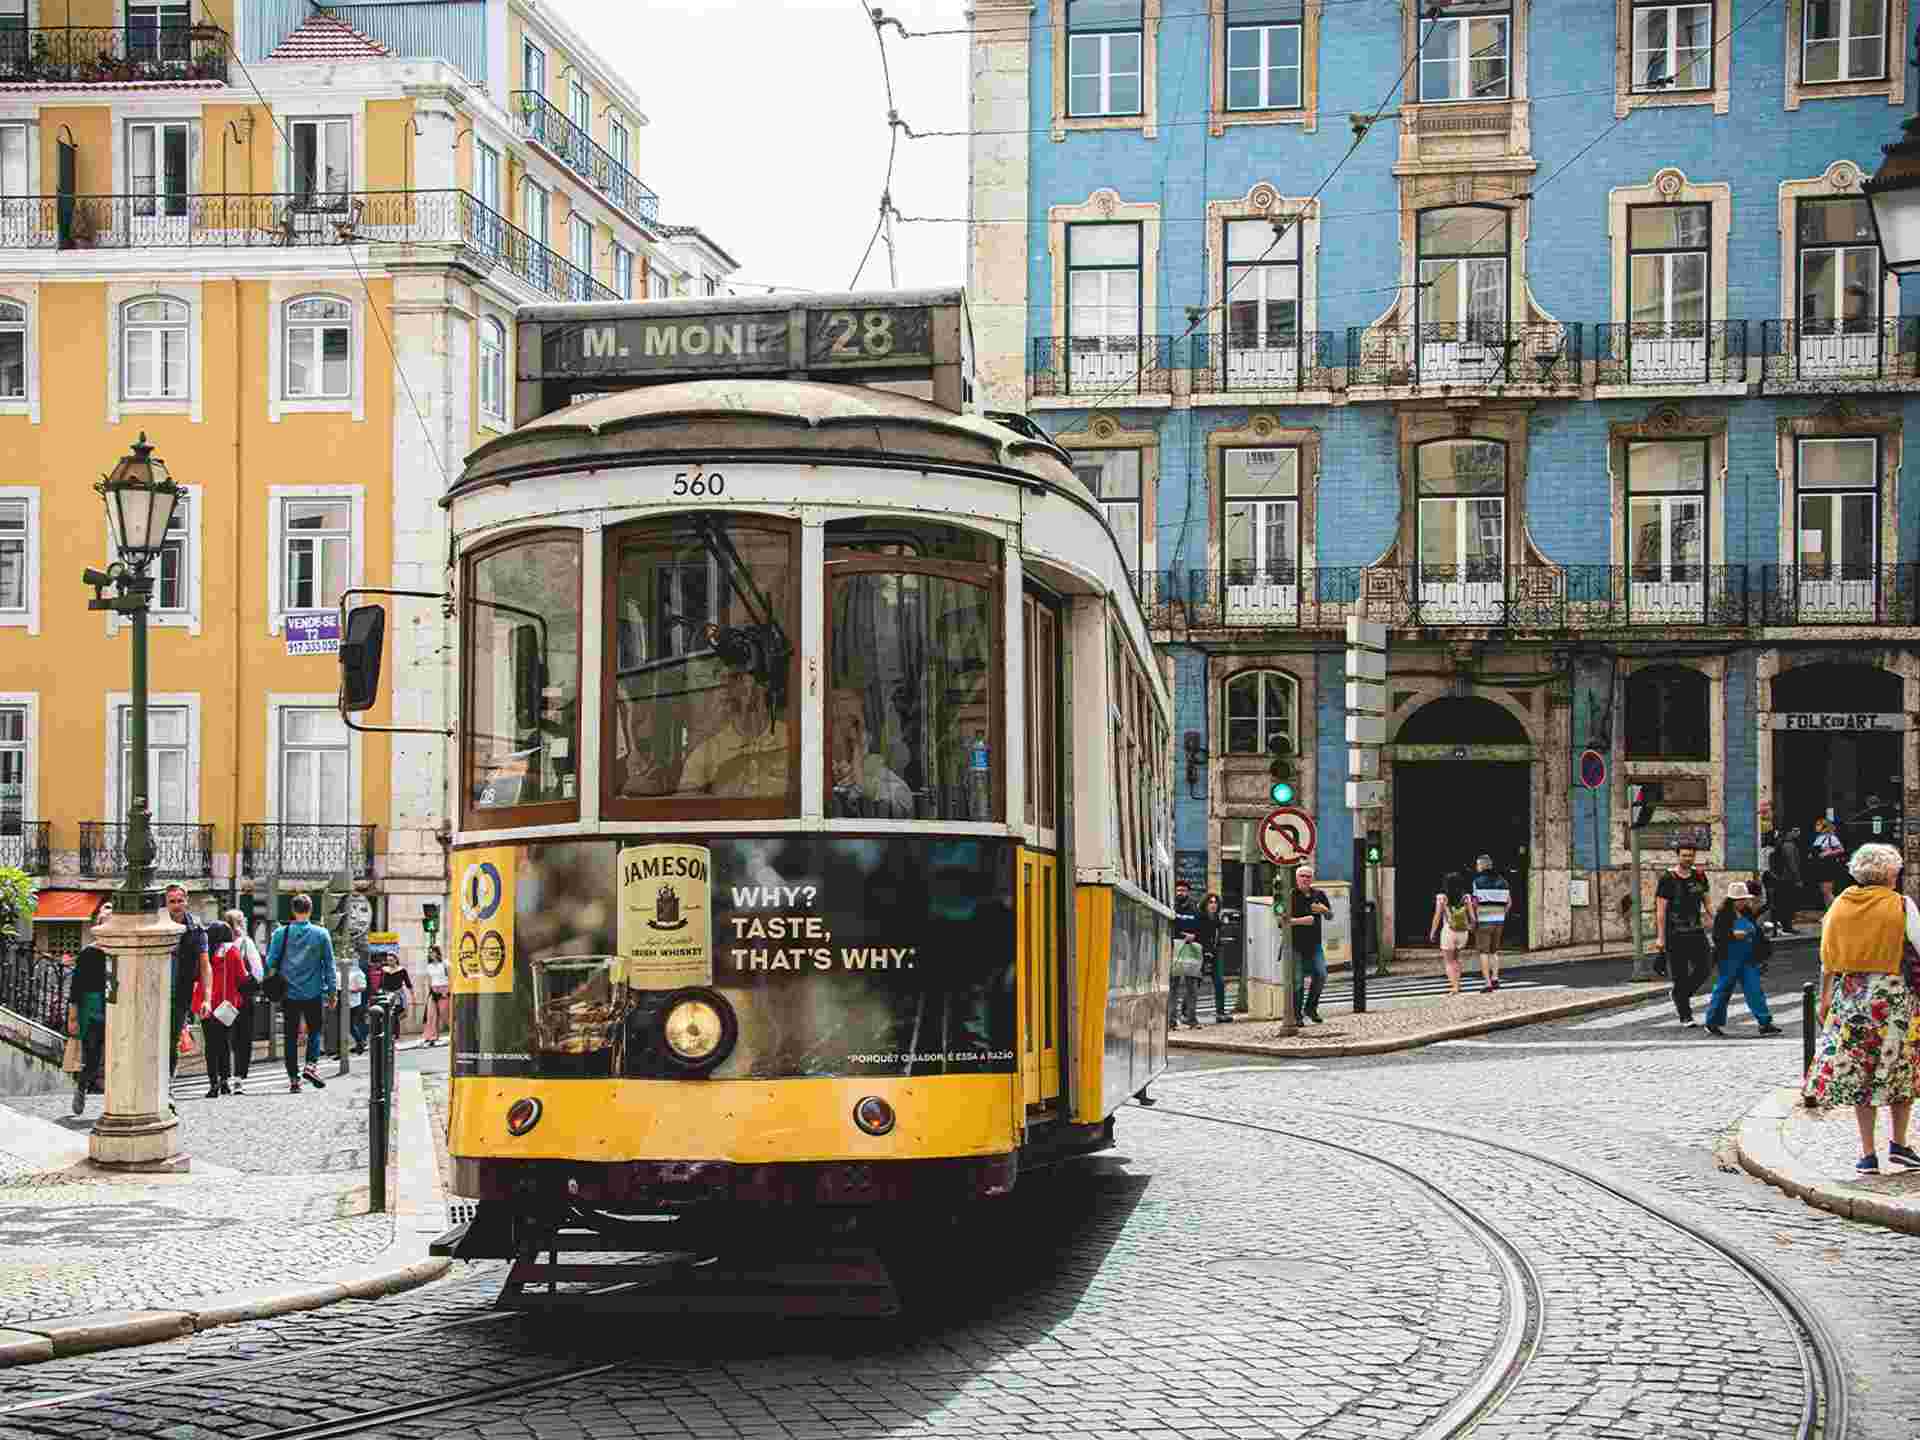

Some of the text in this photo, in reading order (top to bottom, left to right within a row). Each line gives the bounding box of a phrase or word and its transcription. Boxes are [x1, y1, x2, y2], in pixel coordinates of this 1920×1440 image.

[583, 327, 630, 358] M.
[828, 310, 894, 357] 28
[673, 472, 725, 496] 560
[287, 616, 337, 629] VENDE-SE
[305, 629, 320, 641] T2
[1785, 714, 1832, 729] FOLK
[1848, 714, 1880, 729] ART
[623, 855, 707, 886] JAMESON
[731, 886, 817, 908] WHY?
[731, 916, 833, 943] TASTE,
[731, 948, 833, 971] THAT'S
